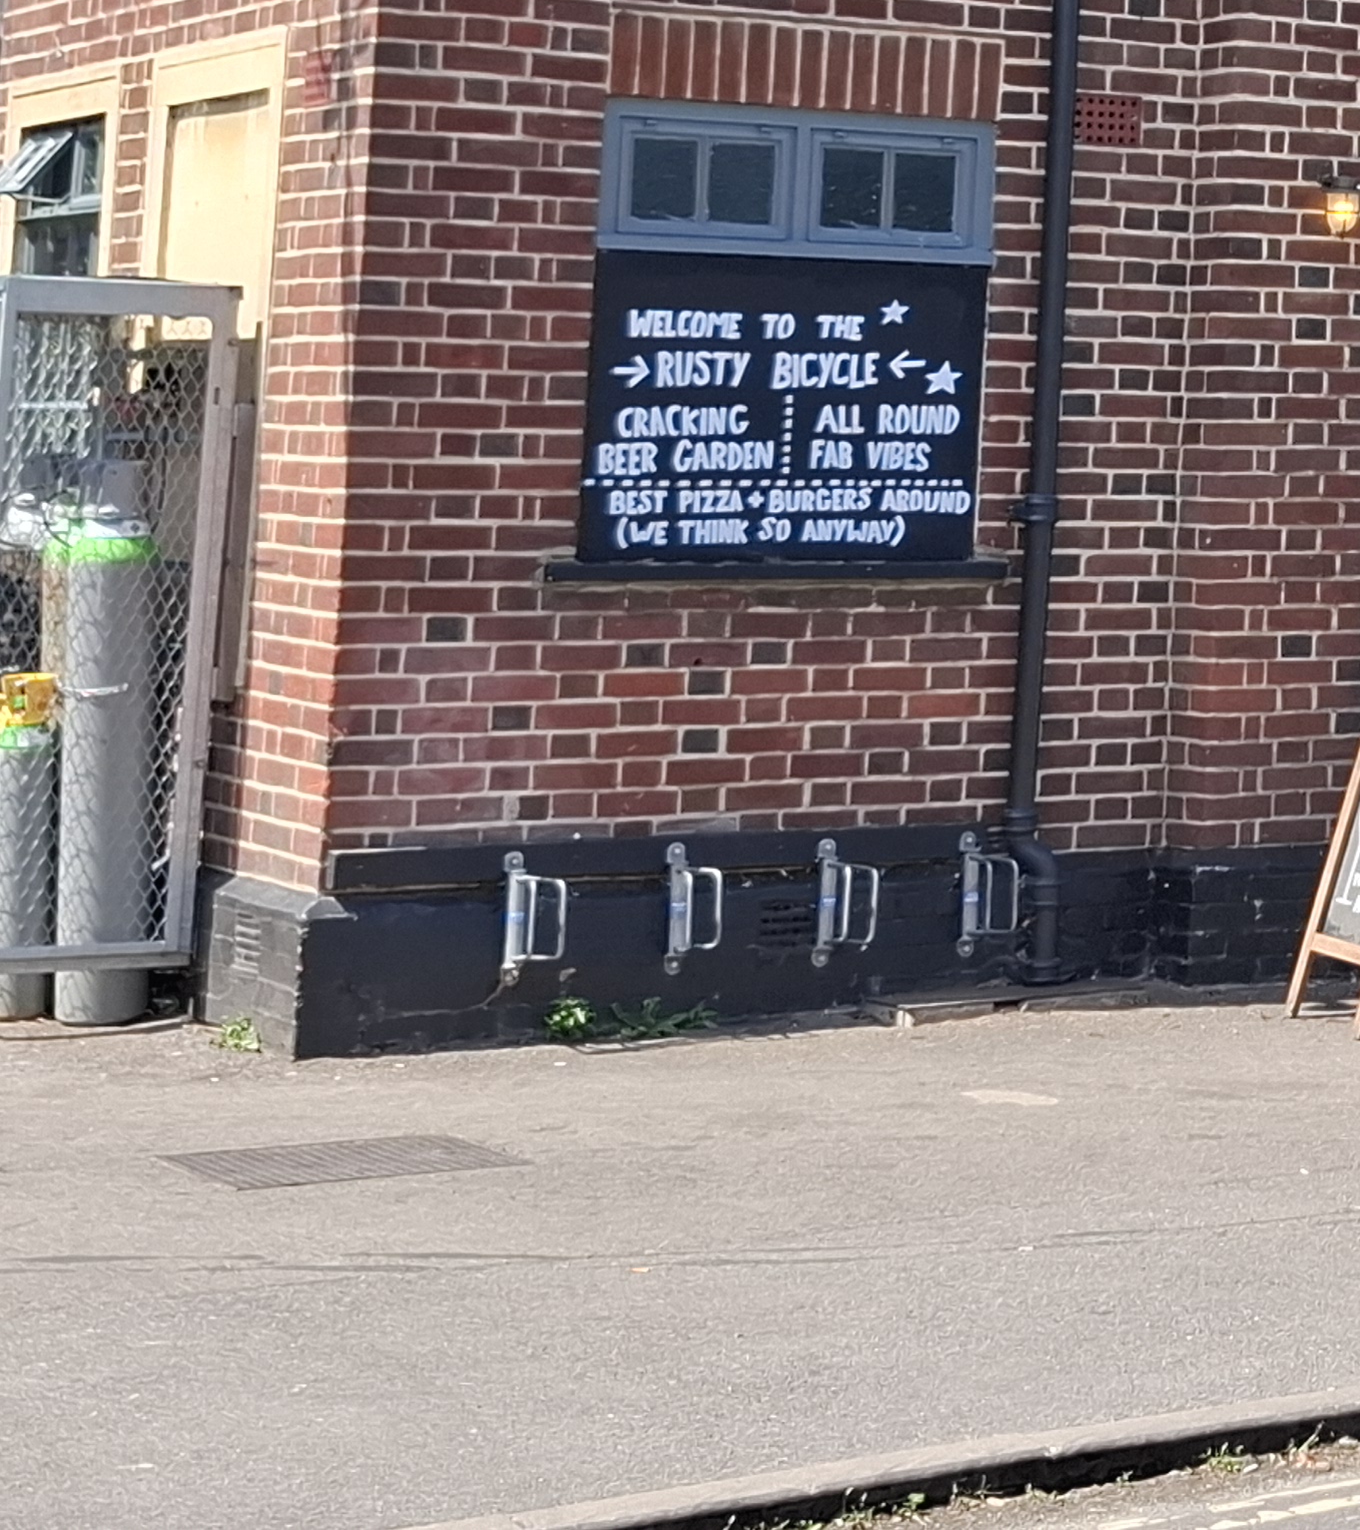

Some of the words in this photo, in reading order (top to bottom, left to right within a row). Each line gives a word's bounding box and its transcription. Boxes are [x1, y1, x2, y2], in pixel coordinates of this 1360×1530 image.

[626, 308, 743, 340] WELCOME
[760, 313, 795, 340] TO
[814, 314, 865, 342] THE
[654, 351, 751, 388] RUSTY
[769, 352, 880, 390] BICYCLE
[617, 404, 750, 438] CRACKING
[814, 404, 865, 436] ALL
[877, 404, 961, 436] ROUND
[598, 441, 659, 476] BEER
[672, 438, 775, 472] GARDEN
[809, 439, 853, 471] FAB
[866, 440, 932, 472] VIBES
[608, 490, 668, 515] BEST
[677, 490, 744, 514] PIZZA
[765, 487, 873, 515] BURGERS
[879, 489, 971, 515] AROUND
[616, 516, 669, 549] (WE
[678, 519, 749, 546] THINK
[757, 518, 792, 543] SO
[801, 515, 906, 548] ANYWAY)
